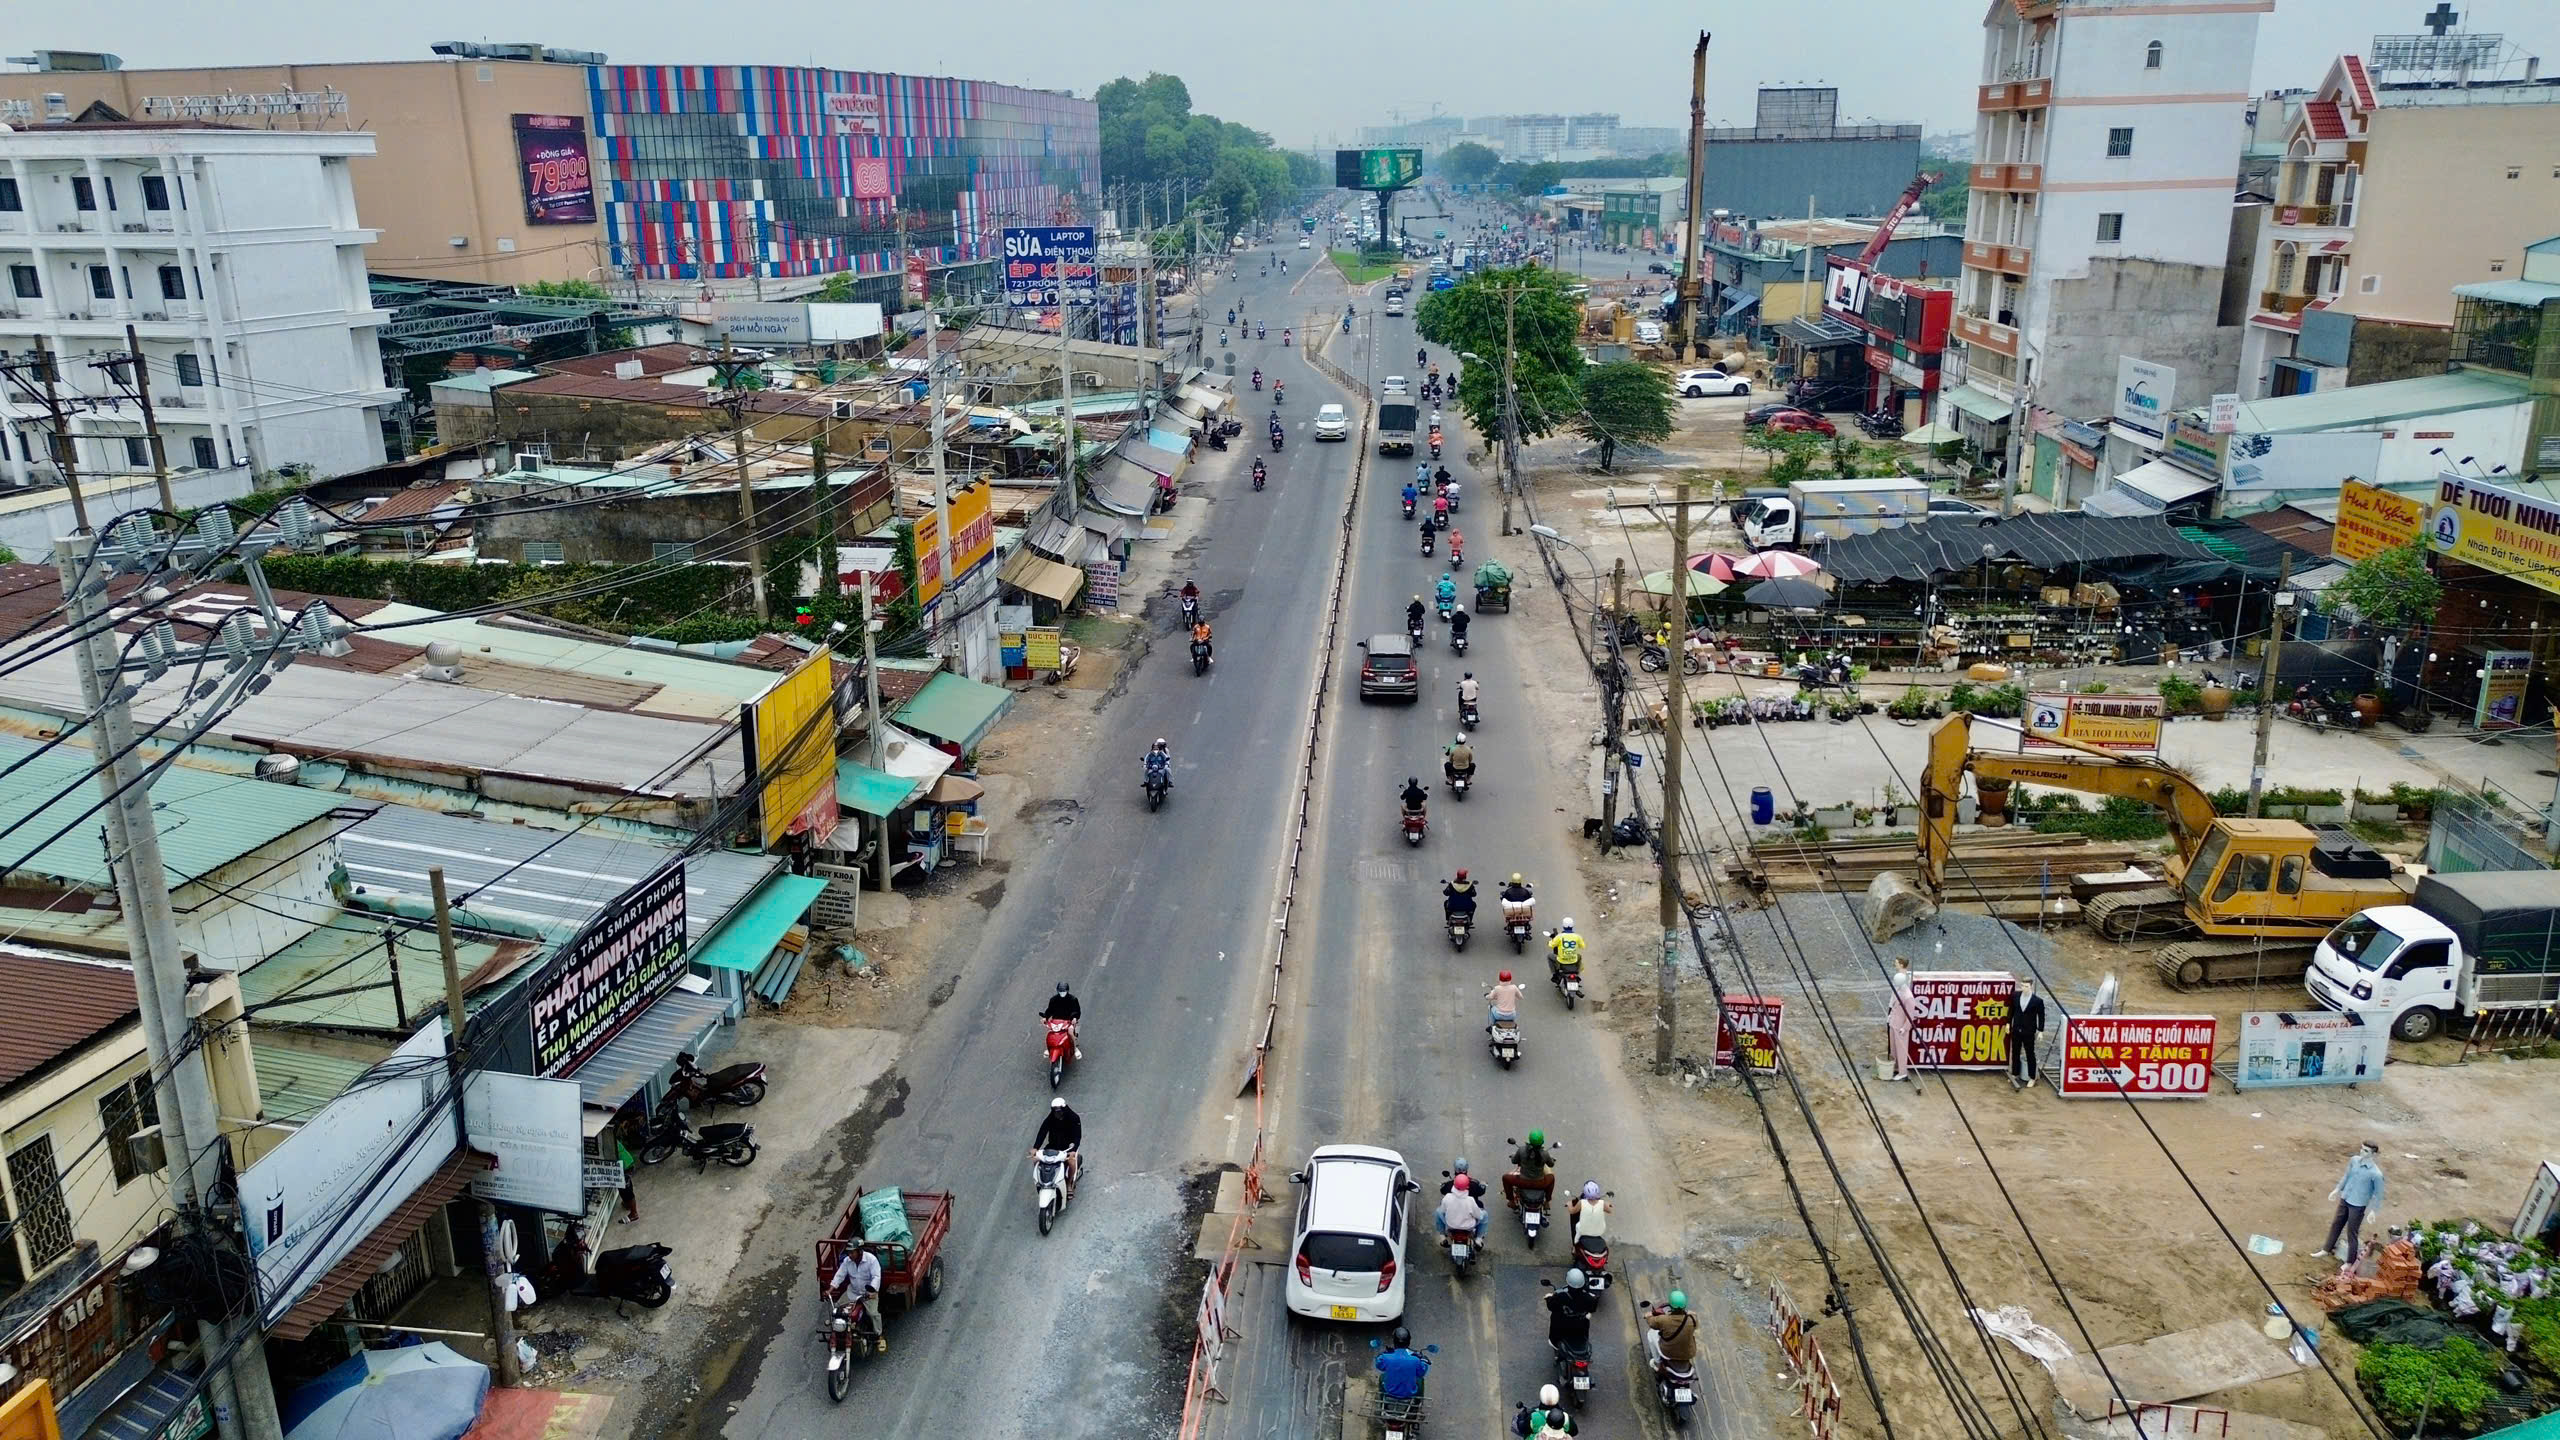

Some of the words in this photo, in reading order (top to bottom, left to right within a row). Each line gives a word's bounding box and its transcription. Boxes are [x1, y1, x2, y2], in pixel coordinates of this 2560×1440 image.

[857, 162, 888, 194] GO!
[1887, 214, 1900, 231] STC
[1005, 230, 1043, 257] SỬA
[1050, 232, 1085, 241] LAPTOP
[1040, 263, 1092, 278] KNH
[730, 325, 745, 333] 24H
[764, 322, 788, 334] NGÀY
[2441, 481, 2465, 507] DÊ
[2469, 490, 2511, 521] TƯƠI
[2495, 527, 2516, 546] BIA
[2103, 704, 2121, 716] NINH
[2143, 705, 2157, 718] 662
[2073, 728, 2089, 736] BIA
[2011, 768, 2068, 780] MITSUBISHI
[816, 869, 833, 878] DUY
[833, 871, 855, 881] KHOA
[580, 930, 604, 957] TÂM
[607, 903, 643, 939] SMART
[646, 873, 681, 909] PHONE
[1562, 938, 1576, 948] be
[534, 973, 584, 1028] PHÁT
[583, 933, 628, 988] MINH
[630, 892, 684, 952] KHANG
[537, 1019, 560, 1050] ÉP
[567, 980, 610, 1025] KÍNH
[650, 917, 684, 957] LIỀN
[1914, 983, 1935, 995] GIẢI
[1937, 983, 1957, 995] CỨU
[1994, 983, 2014, 995] TÂY
[541, 1034, 568, 1066] THU
[569, 1012, 598, 1046] MUA
[597, 988, 624, 1022] MÁY
[622, 970, 638, 998] CŨ
[639, 960, 658, 984] GIÁ
[658, 941, 680, 968] CAO
[575, 1013, 616, 1055] SAMSUNG
[618, 991, 643, 1018] SONY
[643, 971, 668, 998] NOKIA
[668, 953, 687, 975] VIVO
[1913, 996, 1971, 1020] SALE
[1981, 1004, 2003, 1017] TẾT
[1961, 1024, 2007, 1062] 99K
[2102, 1023, 2118, 1042] XẢ
[2121, 1025, 2152, 1043] HÀNG
[2155, 1025, 2182, 1043] CUỐI
[2185, 1024, 2211, 1043] NĂM
[1918, 1045, 1946, 1064] TÂY
[2070, 1046, 2113, 1059] MUA
[2120, 1047, 2132, 1059] 2
[2139, 1044, 2191, 1064] TẶNG
[2200, 1046, 2208, 1059] 1
[2072, 1069, 2089, 1081] 3
[2137, 1063, 2206, 1089] 500
[60, 1283, 104, 1331] GIA
